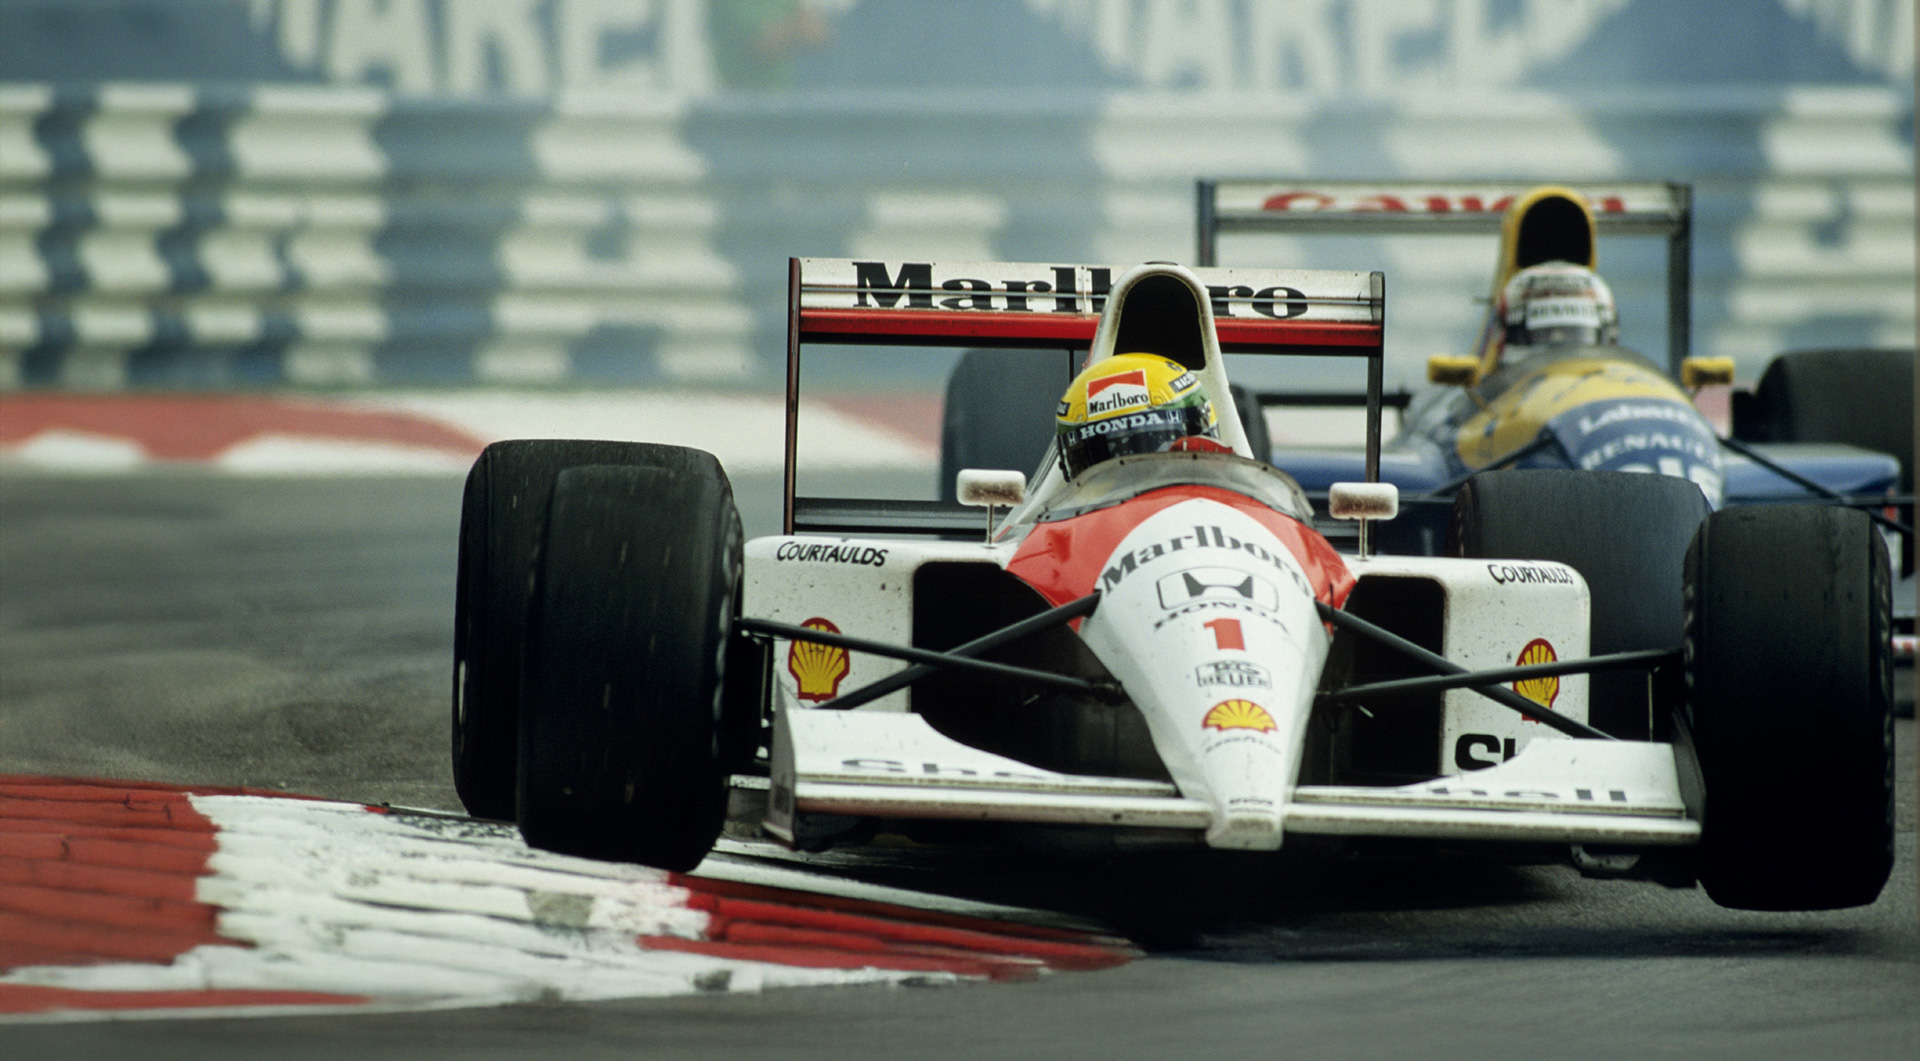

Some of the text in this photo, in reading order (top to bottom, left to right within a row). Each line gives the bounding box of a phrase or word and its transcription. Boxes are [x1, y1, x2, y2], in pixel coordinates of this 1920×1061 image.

[852, 262, 1309, 319] Marlro
[1088, 391, 1149, 415] Marlboro
[1079, 412, 1164, 440] HONDA
[777, 541, 889, 567] COURTAULDS
[1101, 525, 1310, 595] Marlboro
[1487, 564, 1574, 585] COURTAULDS
[1153, 600, 1291, 637] HONDA
[1202, 617, 1246, 651] 1
